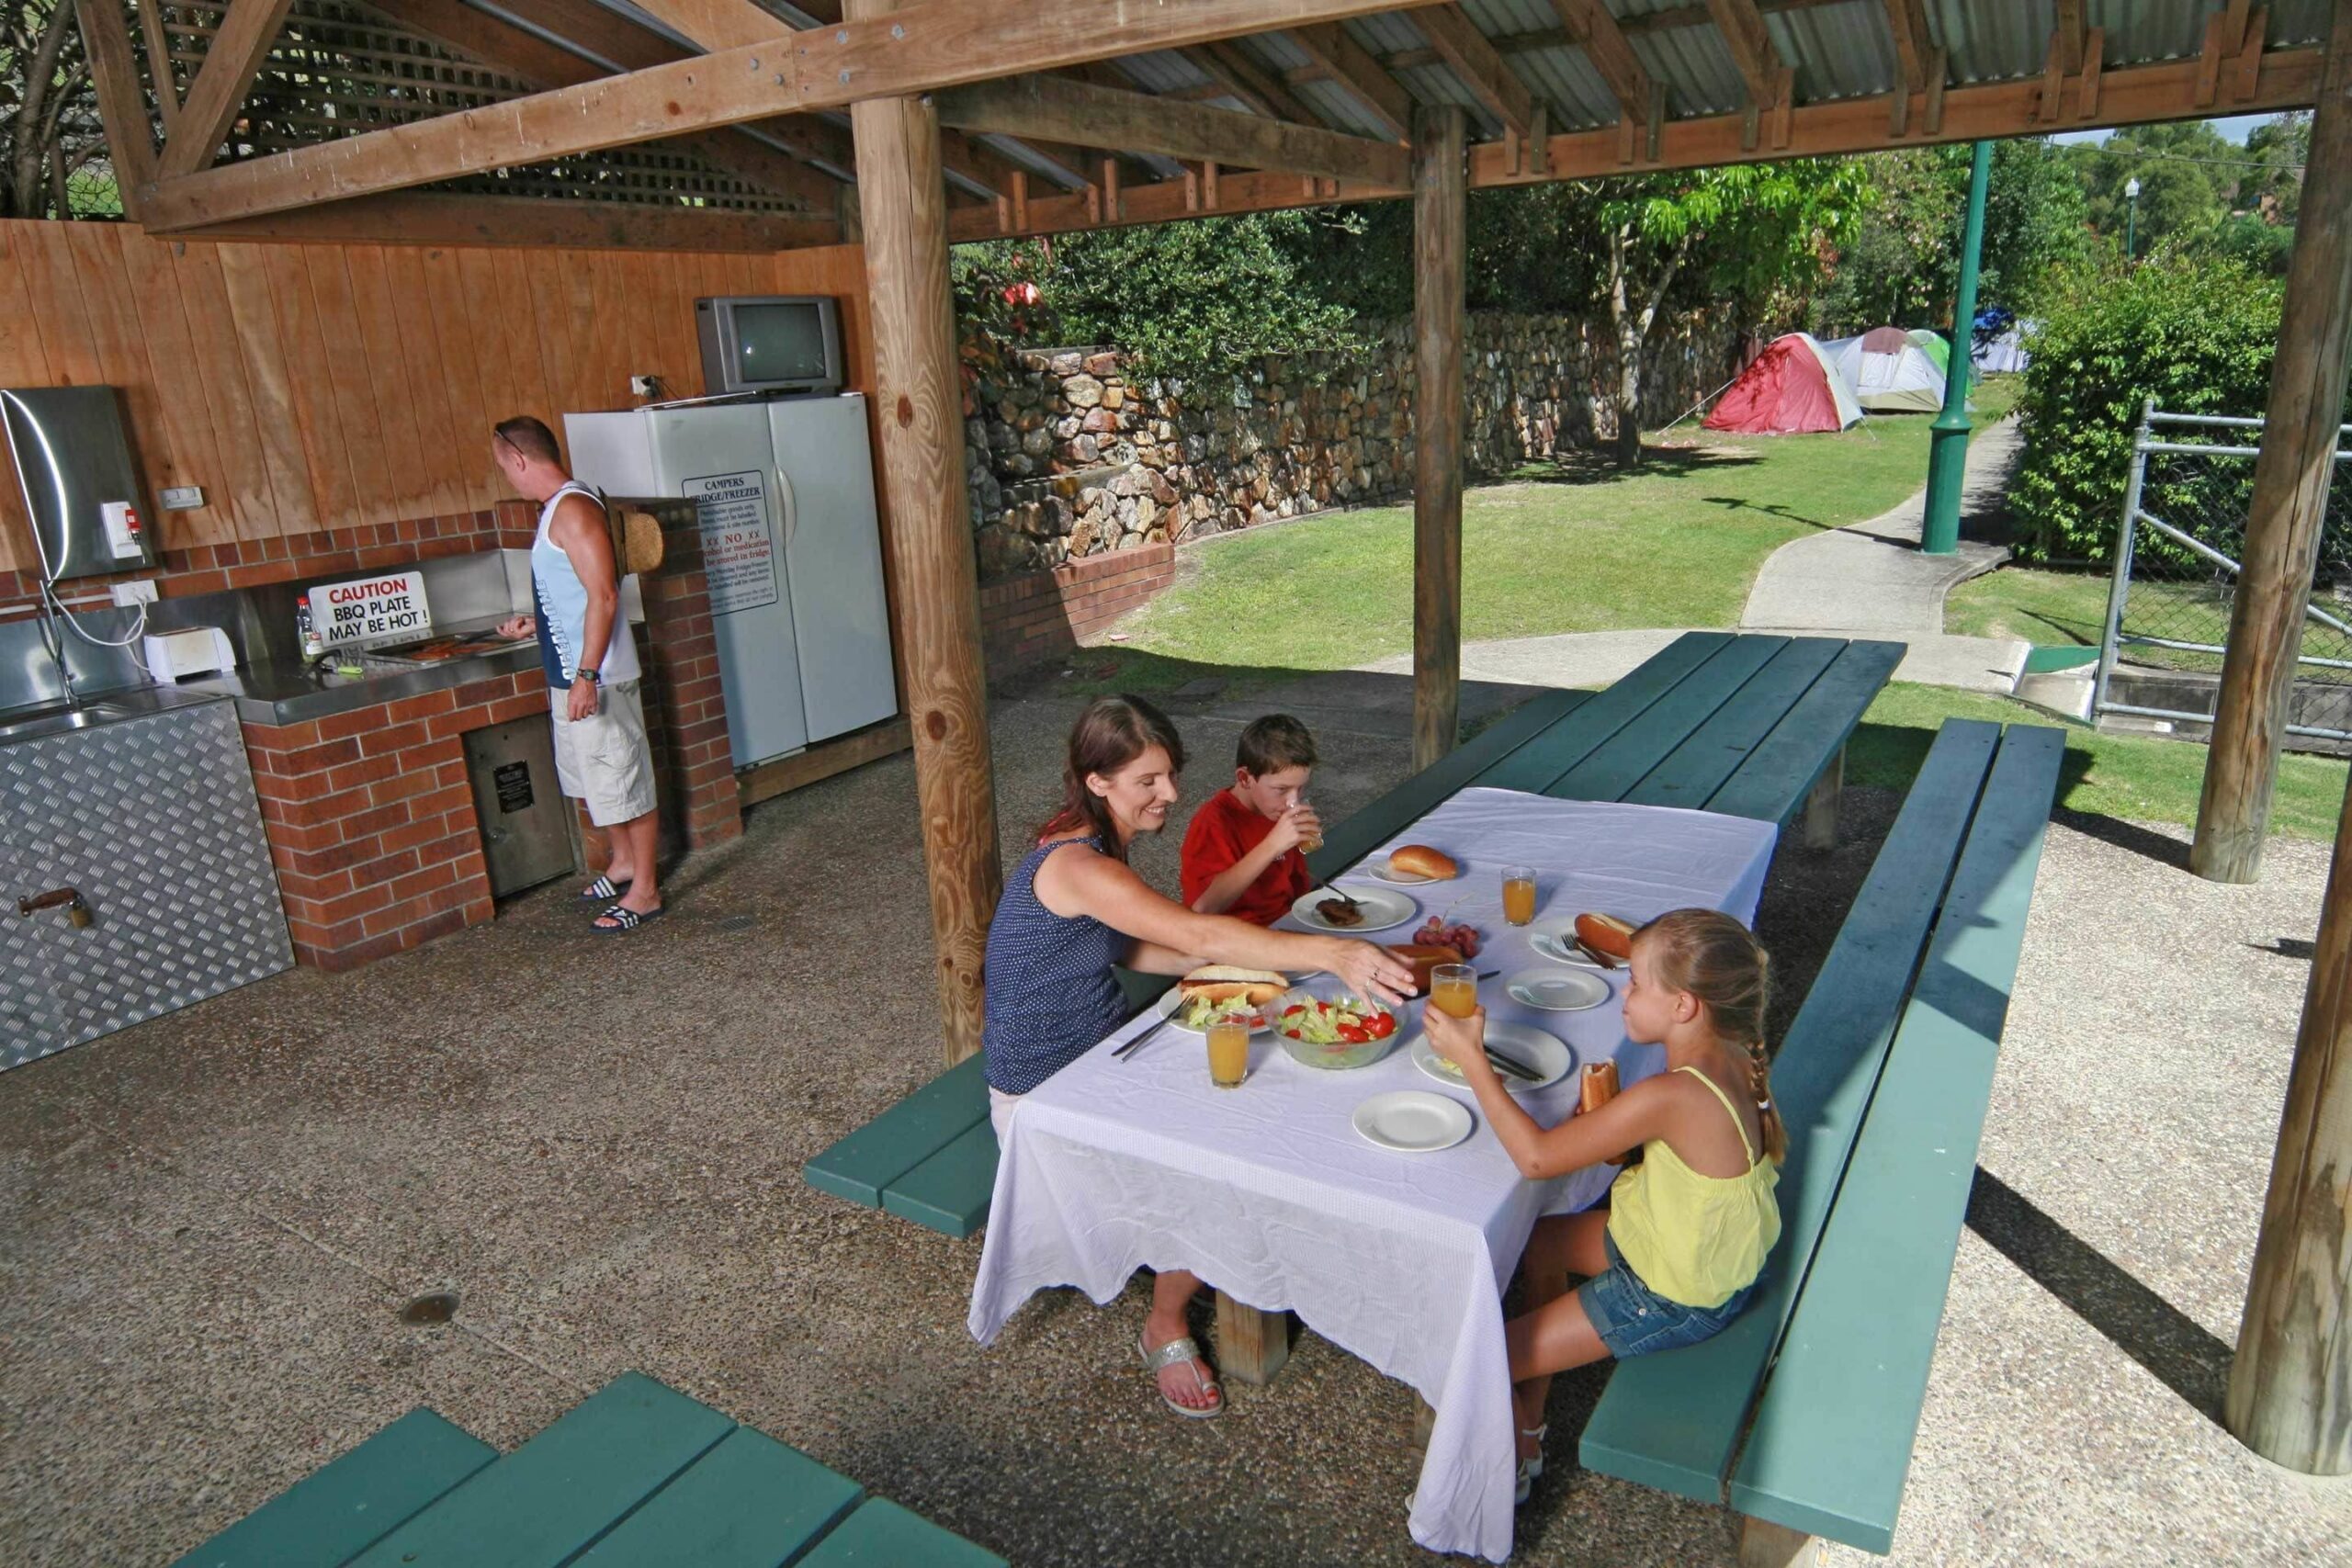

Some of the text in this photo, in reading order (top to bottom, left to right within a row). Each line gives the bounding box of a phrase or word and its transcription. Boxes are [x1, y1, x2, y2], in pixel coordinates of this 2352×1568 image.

[692, 487, 760, 503] RIDGE/FREEZER
[705, 478, 744, 490] CAMPERS
[725, 533, 742, 544] NO
[329, 578, 408, 604] CAUTION
[334, 596, 412, 622] BBQ PLATE
[329, 622, 362, 641] MAY
[368, 617, 386, 633] BE
[390, 612, 419, 629] HOT
[548, 619, 577, 680] OCEAN
